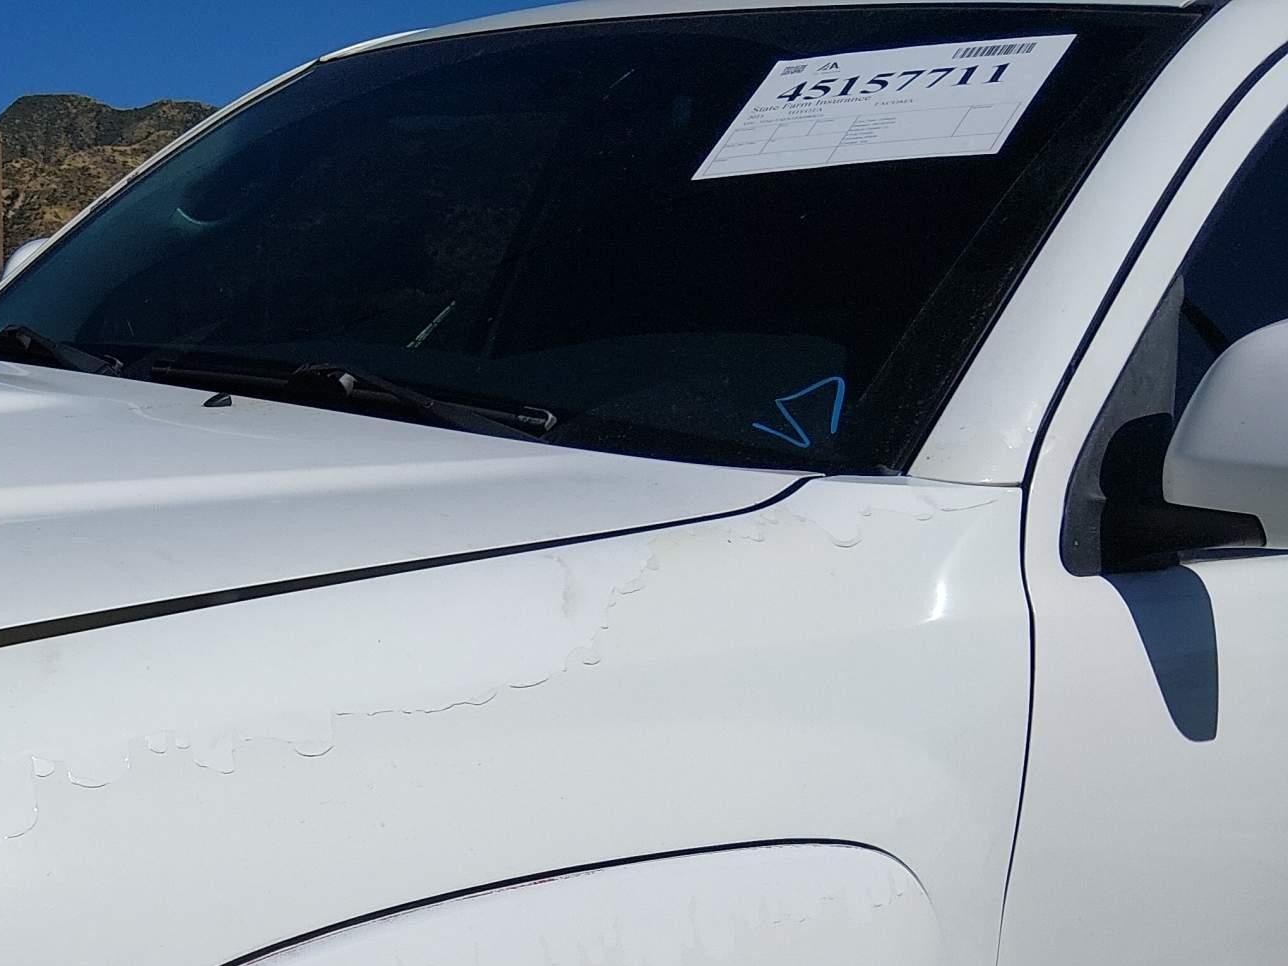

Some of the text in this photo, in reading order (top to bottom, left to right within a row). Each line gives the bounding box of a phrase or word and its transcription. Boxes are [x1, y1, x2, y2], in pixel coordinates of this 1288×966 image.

[777, 63, 1010, 102] 45157711
[752, 96, 871, 113] State Farm Insurance
